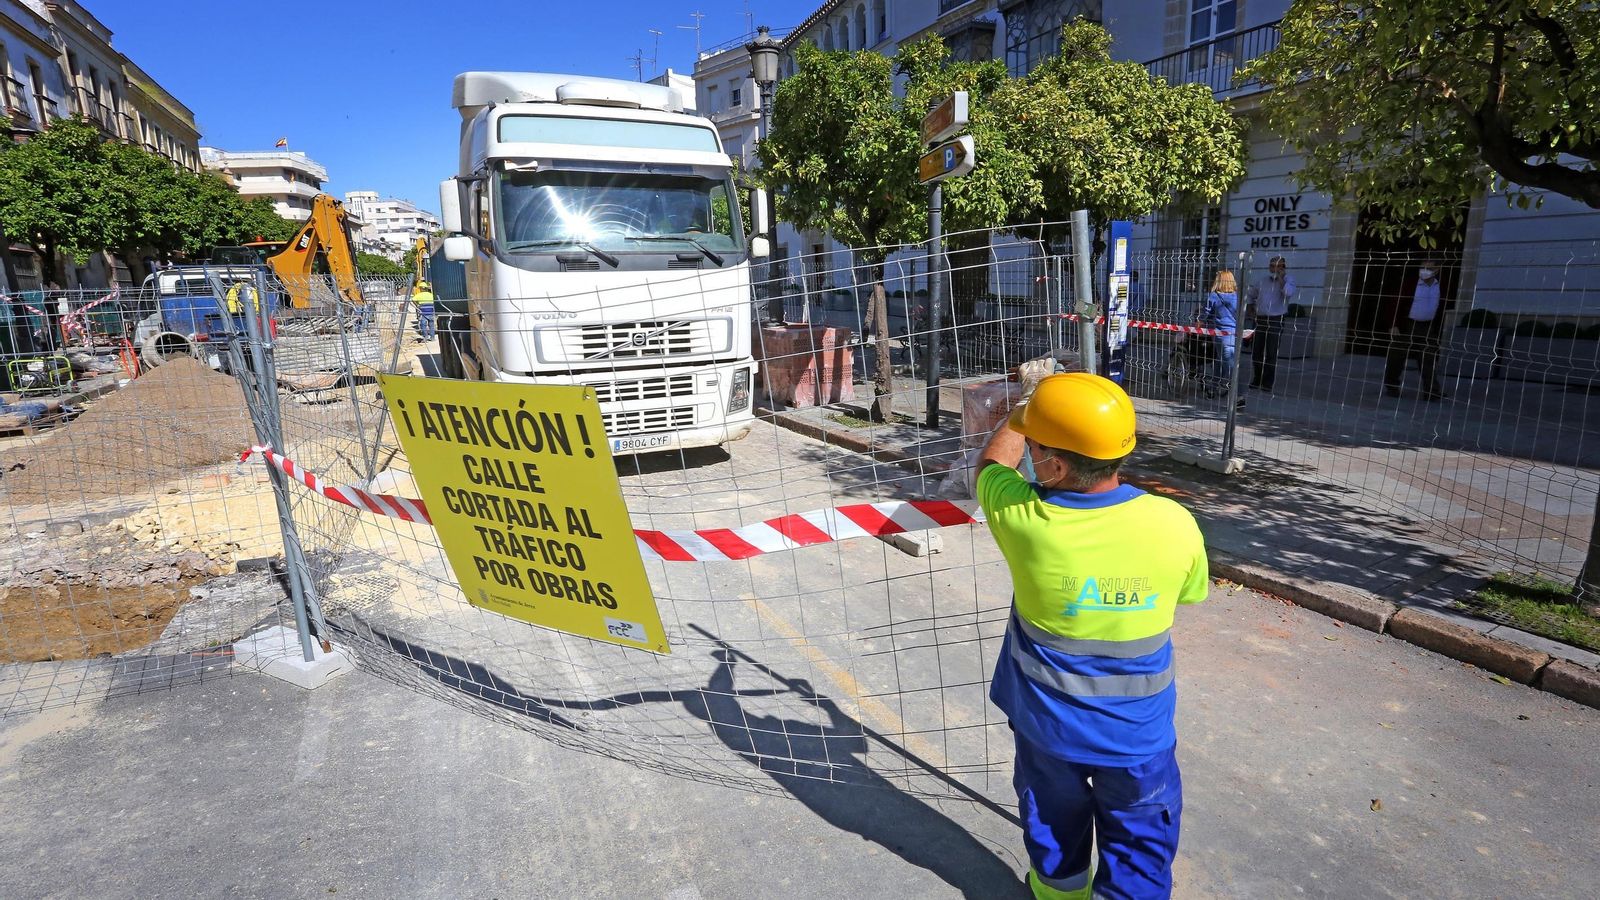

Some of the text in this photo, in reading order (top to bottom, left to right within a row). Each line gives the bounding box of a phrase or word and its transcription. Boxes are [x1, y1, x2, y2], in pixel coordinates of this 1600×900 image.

[945, 149, 953, 168] P
[1254, 195, 1302, 214] ONLY
[1243, 213, 1310, 232] SUITES
[1250, 235, 1298, 249] HOTEL
[531, 311, 578, 320] VOLVO
[622, 436, 669, 449] 9804 CYF
[462, 454, 546, 494] CALLE
[442, 486, 603, 540] CORTADA AL
[474, 524, 587, 572] TRÁFICO
[473, 555, 618, 610] POR OBRAS
[1062, 576, 1152, 595] MANUEL
[1077, 576, 1139, 605] ALBA
